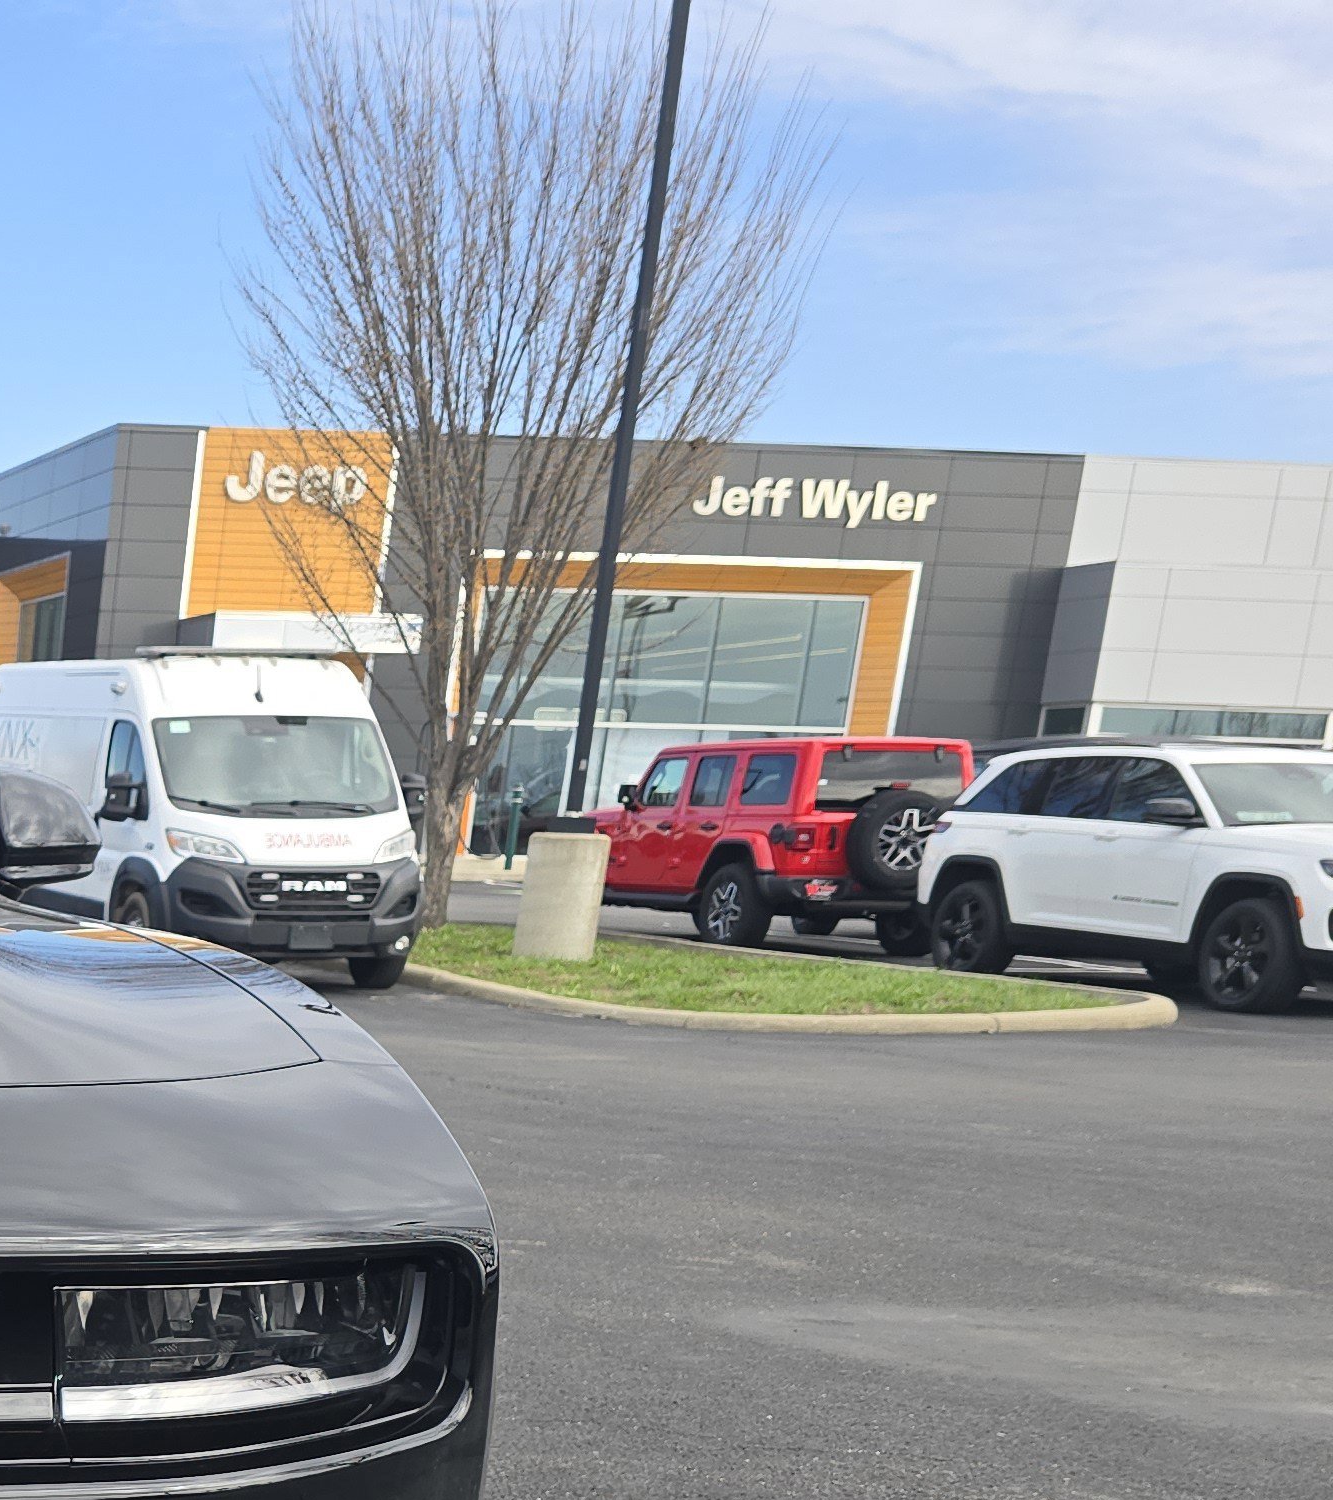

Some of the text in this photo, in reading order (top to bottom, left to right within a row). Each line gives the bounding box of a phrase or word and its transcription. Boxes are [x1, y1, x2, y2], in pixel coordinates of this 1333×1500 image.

[225, 450, 369, 509] Jeep
[692, 475, 937, 529] Jeff Wyler
[281, 880, 347, 892] RAM
